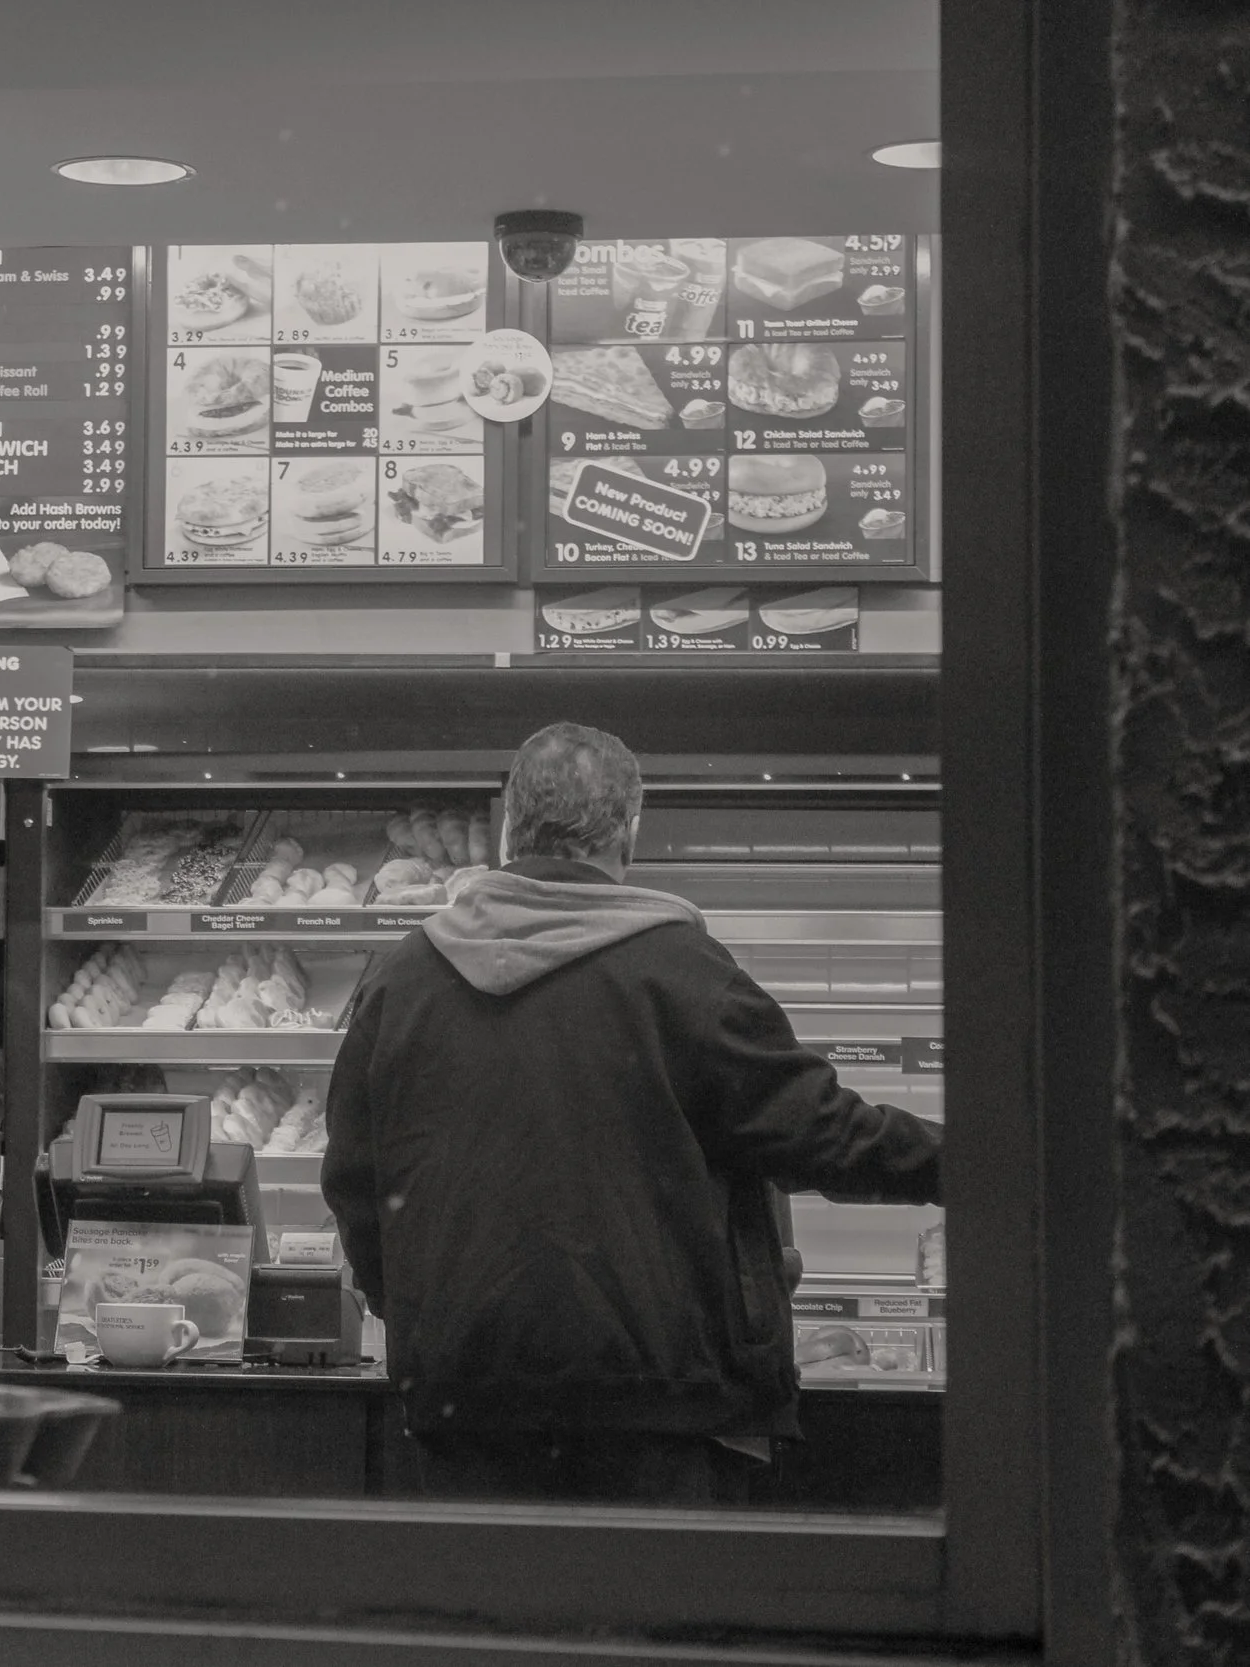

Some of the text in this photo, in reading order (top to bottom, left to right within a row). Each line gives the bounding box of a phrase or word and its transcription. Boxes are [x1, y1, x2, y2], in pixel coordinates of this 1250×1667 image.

[84, 267, 126, 282] 3.49
[96, 287, 125, 300] .99
[96, 325, 124, 339] .99
[737, 319, 753, 338] 11
[172, 329, 205, 342] 3.29
[277, 330, 308, 341] 2.89
[85, 344, 126, 358] 1.39
[665, 346, 721, 365] 4.99
[173, 352, 186, 370] 4
[386, 350, 398, 368] 5
[853, 353, 886, 363] 4.99
[95, 363, 124, 377] .99
[321, 370, 374, 381] Medium
[325, 385, 369, 397] Coffee
[320, 400, 373, 412] Combos
[83, 421, 124, 435] 3.69
[383, 440, 415, 450] 4.39
[561, 432, 575, 450] 9
[734, 430, 756, 449] 12
[83, 440, 124, 454] 3.49
[170, 441, 203, 452] 4.39
[83, 459, 124, 473] 3.49
[278, 461, 290, 479] 7
[385, 460, 397, 479] 8
[664, 458, 720, 477] 4.99
[853, 465, 886, 474] 4.99
[595, 481, 688, 523] New Product
[10, 503, 121, 515] Add Hash Browns
[12, 520, 41, 532] your
[44, 517, 78, 529] order
[80, 517, 120, 532] today!
[575, 496, 695, 546] COMING SOON!
[166, 551, 199, 562] 4.39
[275, 552, 307, 563] 4.39
[382, 551, 416, 562] 4.79
[555, 543, 579, 561] 10
[735, 542, 757, 560] 13
[539, 634, 571, 648] 1.29
[646, 635, 680, 648] 1.39
[752, 635, 787, 648] 0.99
[14, 697, 61, 711] YOUR
[7, 736, 41, 749] HAS
[88, 917, 123, 925] Sprinkles
[202, 915, 264, 923] Cheddar Cheese
[211, 921, 233, 930] Bagel
[828, 1053, 885, 1062] Cheese Danish
[835, 1046, 877, 1056] Strawberry
[874, 1299, 921, 1308] Reduced Fat
[879, 1306, 916, 1314] Blueberry
